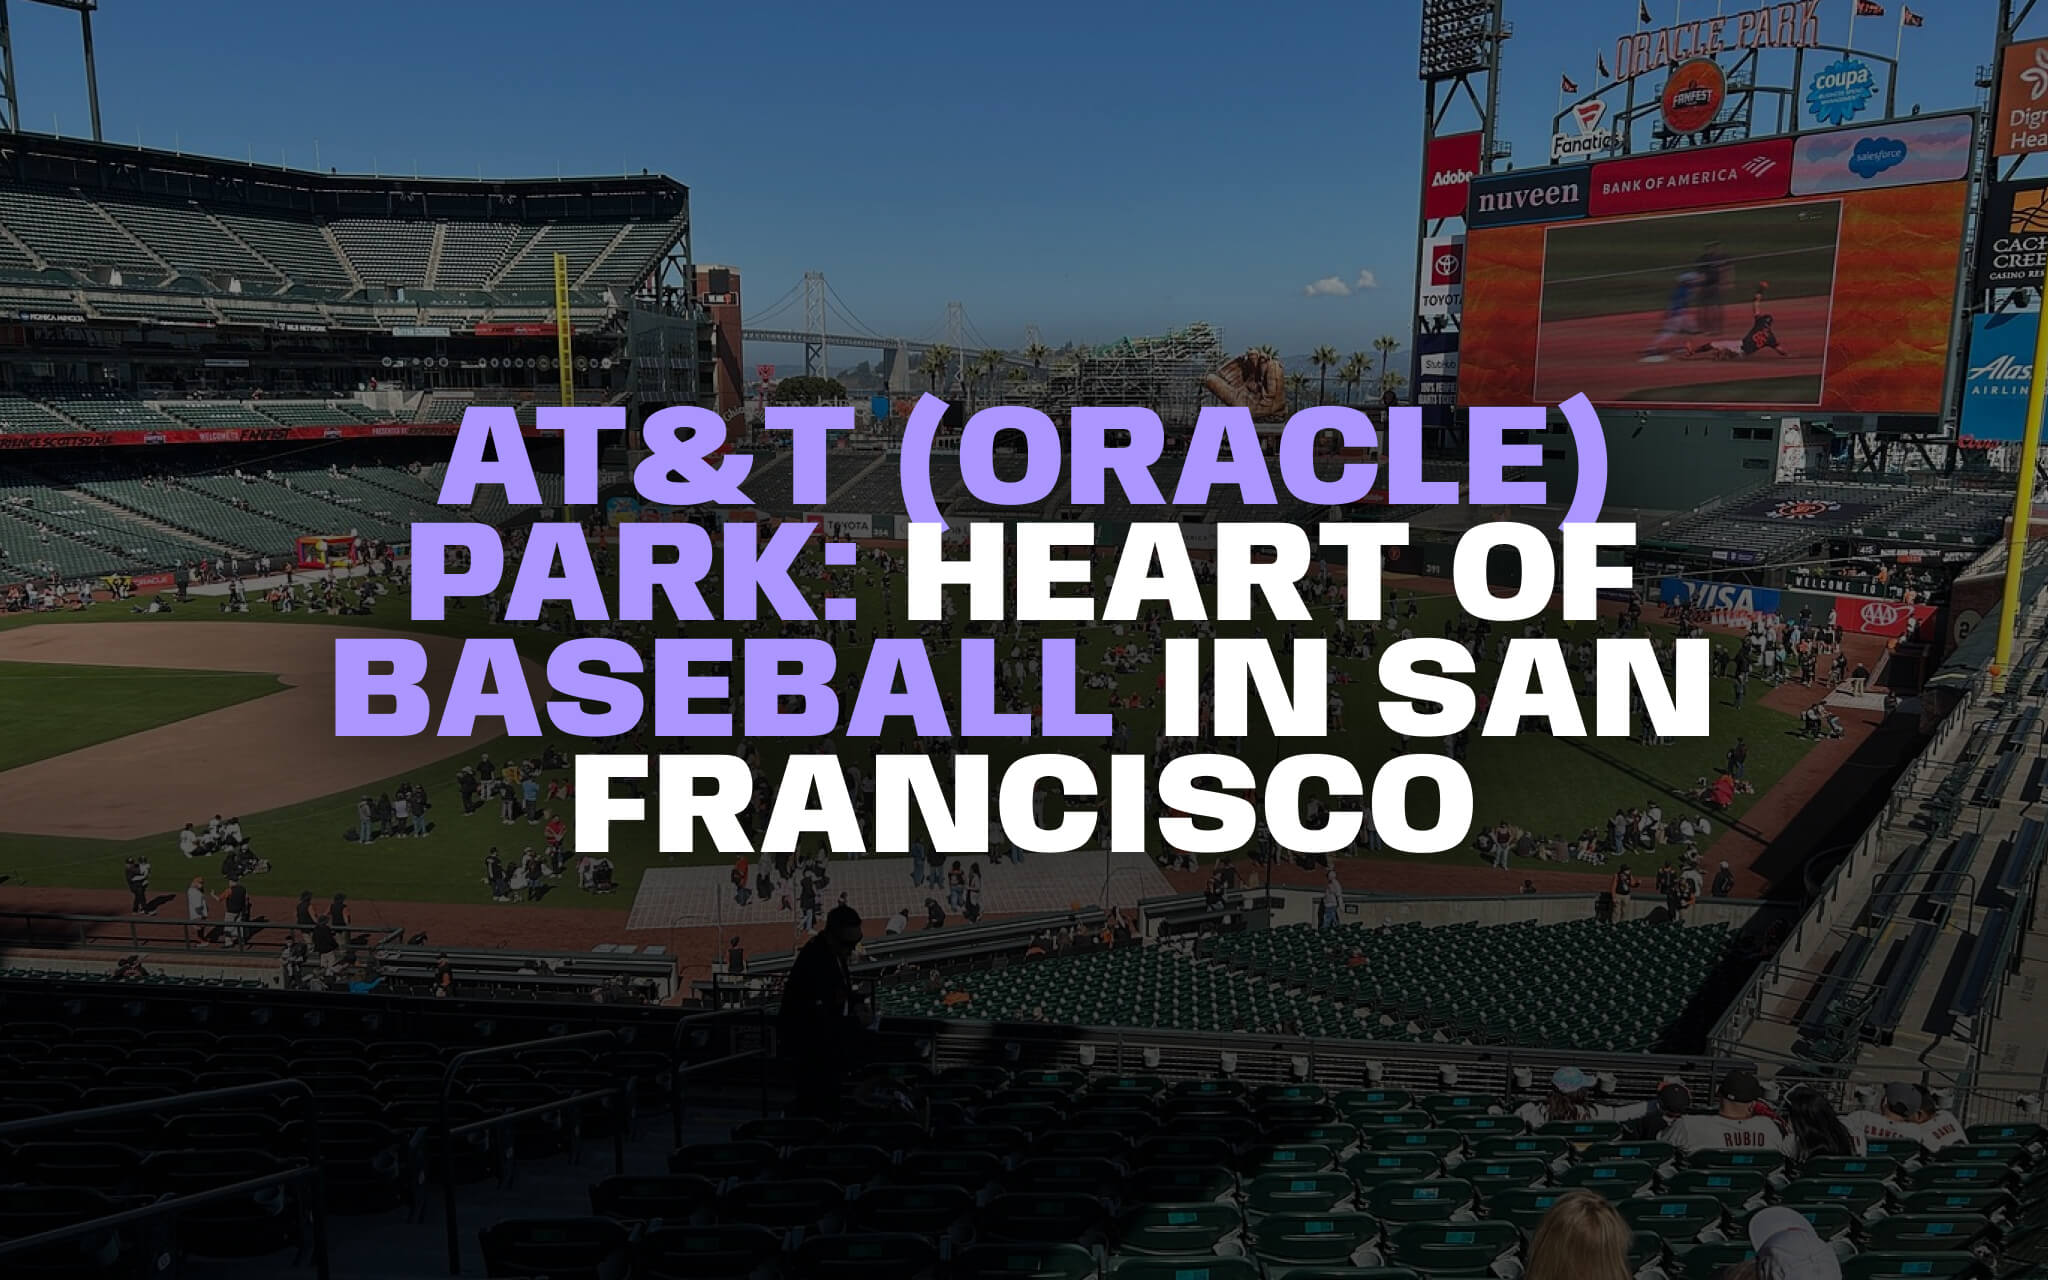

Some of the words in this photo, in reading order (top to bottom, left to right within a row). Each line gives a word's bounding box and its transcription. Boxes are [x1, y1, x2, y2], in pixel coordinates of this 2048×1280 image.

[1615, 16, 1727, 82] ORACLE
[1735, 0, 1820, 49] PARK
[1815, 68, 1869, 90] coupa
[1554, 130, 1625, 154] Fanatics
[1857, 150, 1902, 161] salesforce
[1431, 168, 1473, 188] Adobe
[1602, 178, 1641, 196] BANK
[1645, 176, 1664, 190] OF
[1665, 167, 1738, 188] AMERICA
[1478, 183, 1580, 213] nuveen
[1989, 270, 2026, 281] CASINO
[1967, 354, 2033, 381] Alas
[1971, 385, 2030, 396] AIRLIN
[826, 520, 870, 531] TOYOTA
[1795, 575, 1851, 594] WELCOME
[1862, 583, 1876, 595] TO
[1682, 581, 1755, 614] VISA
[1864, 605, 1894, 623] AAA
[1723, 1131, 1765, 1147] RUBIO
